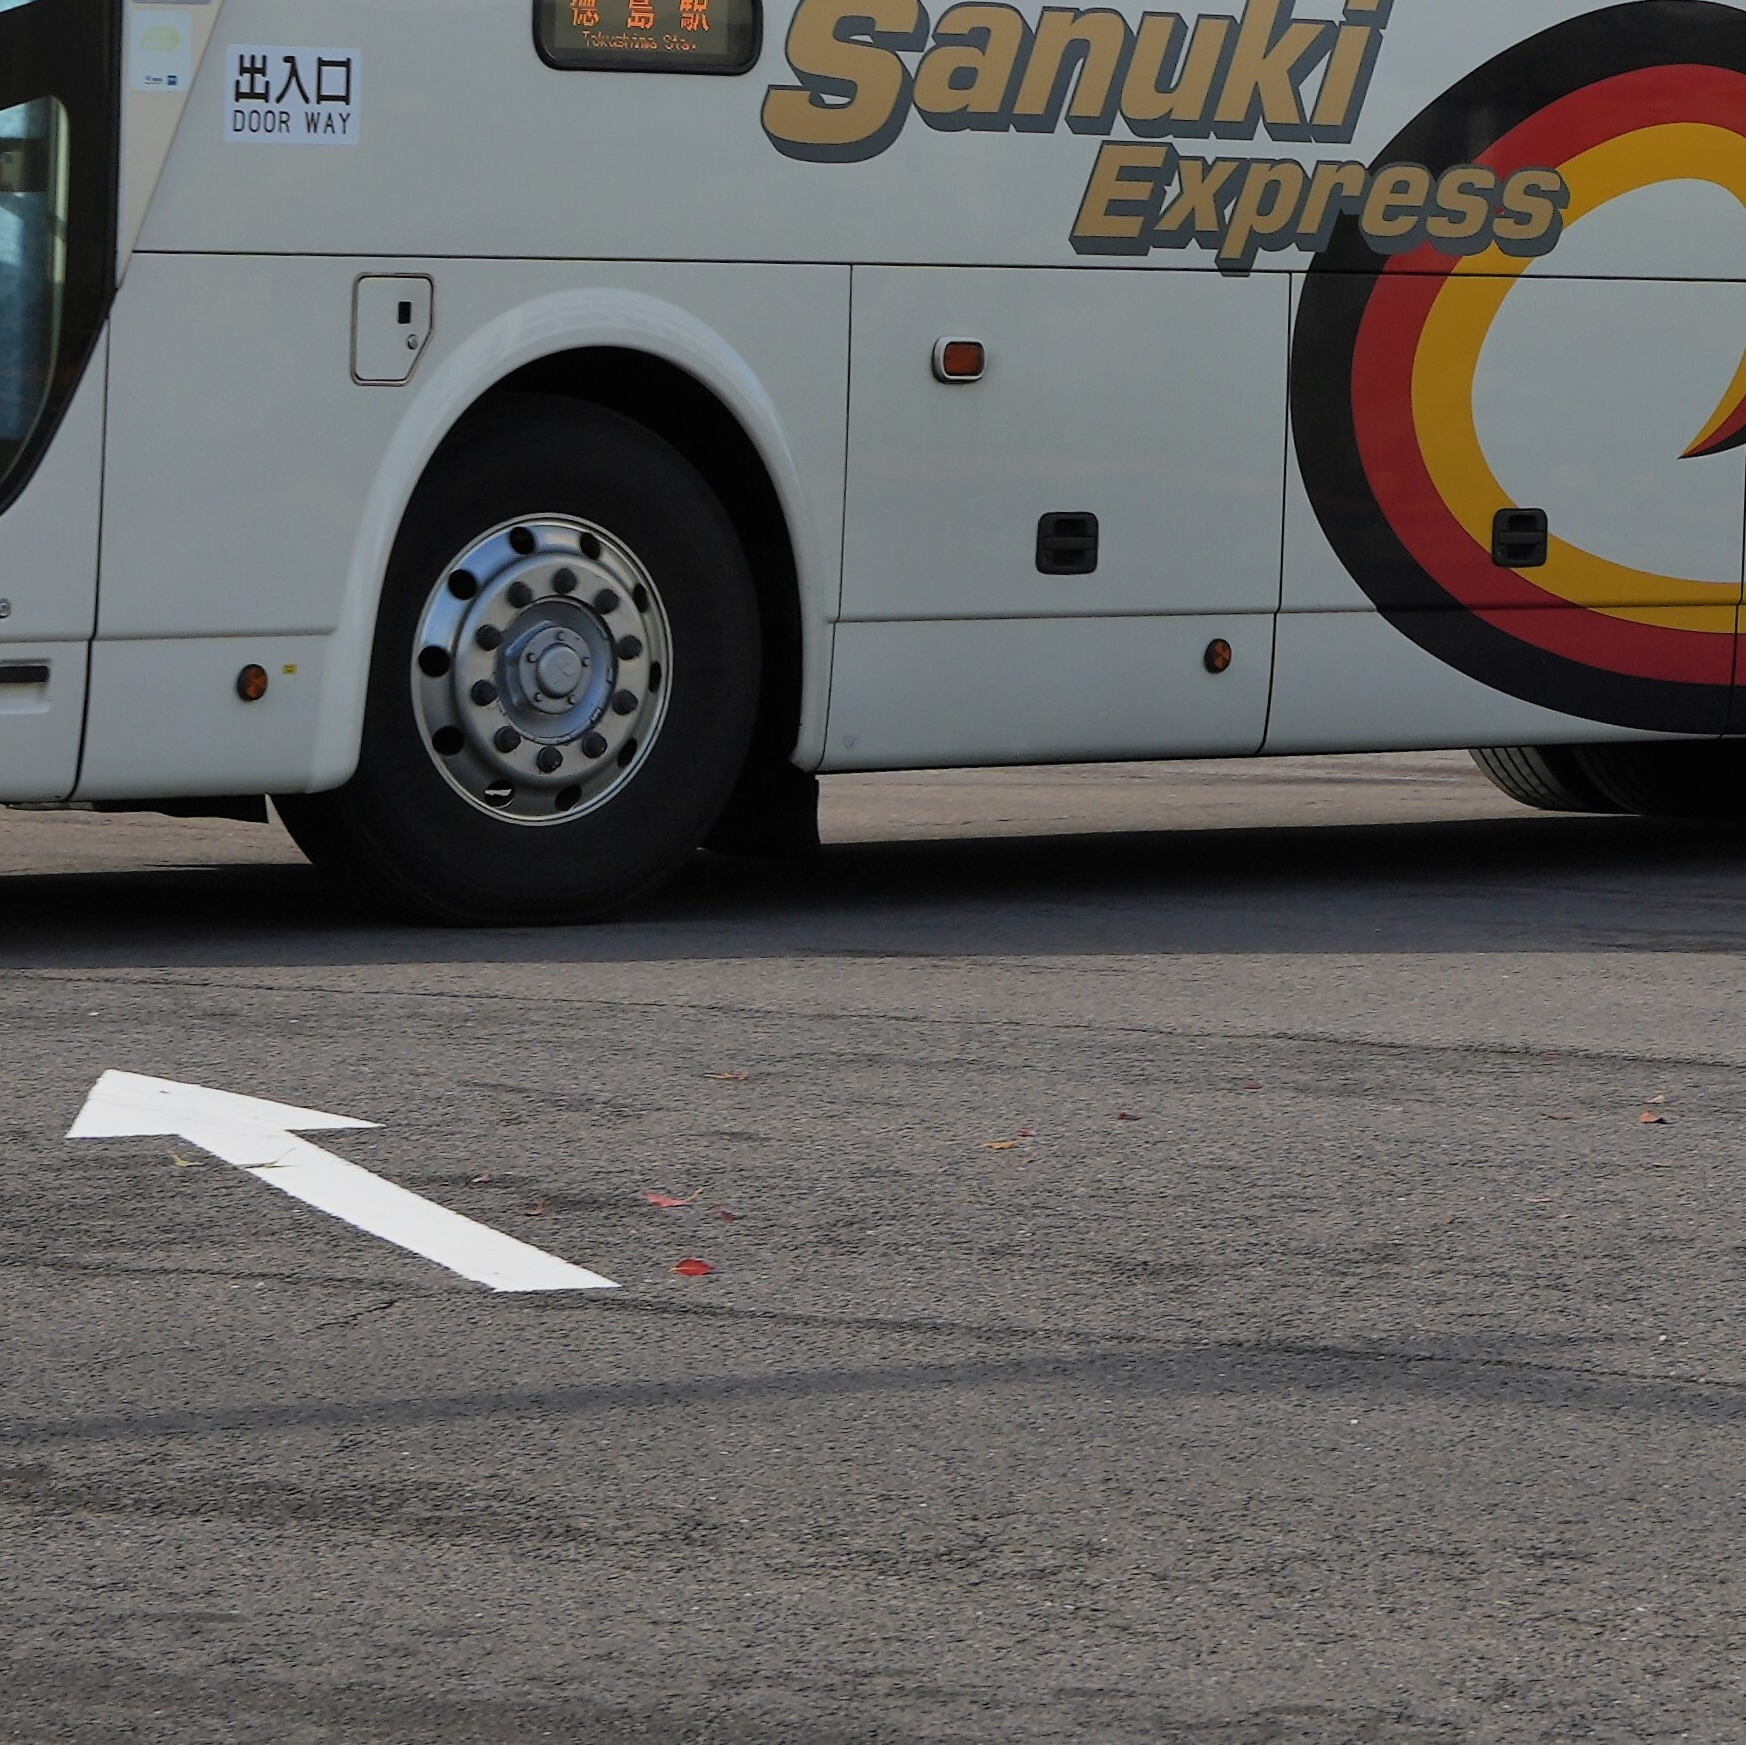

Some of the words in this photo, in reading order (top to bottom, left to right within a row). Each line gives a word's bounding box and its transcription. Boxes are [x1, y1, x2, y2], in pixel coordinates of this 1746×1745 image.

[582, 30, 659, 51] Tokushima
[235, 53, 352, 106] 出入口
[233, 109, 291, 133] DOOR
[305, 111, 351, 134] WAY
[1068, 140, 1573, 277] Express
